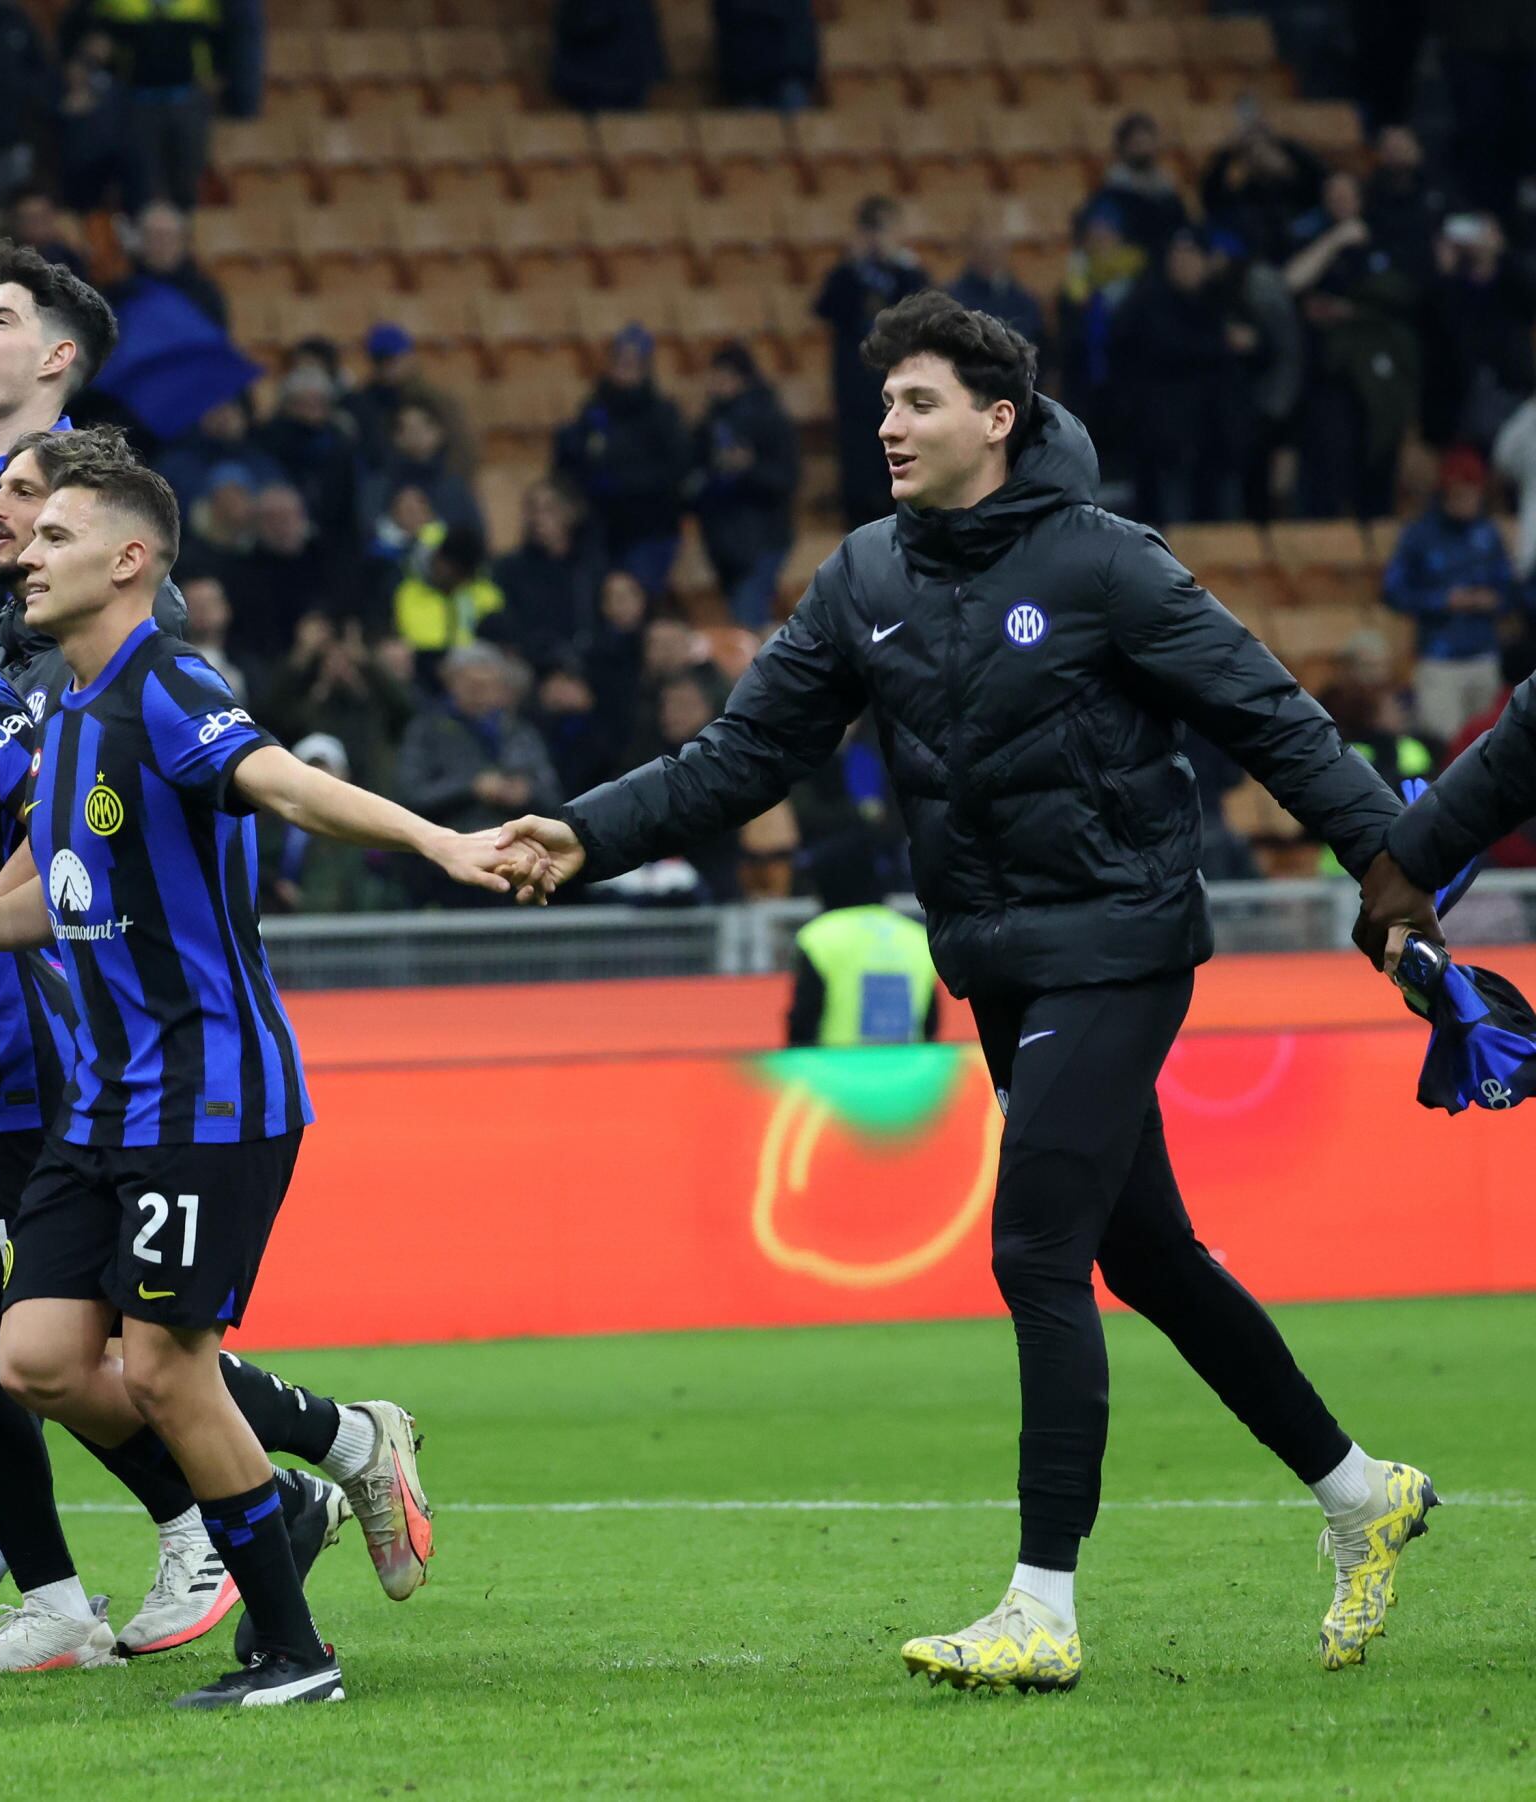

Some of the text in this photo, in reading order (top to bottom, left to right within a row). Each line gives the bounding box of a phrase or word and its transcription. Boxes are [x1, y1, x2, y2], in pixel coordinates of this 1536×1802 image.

[198, 707, 255, 745] eba
[1481, 1078, 1512, 1111] eb
[133, 1192, 199, 1267] 21
